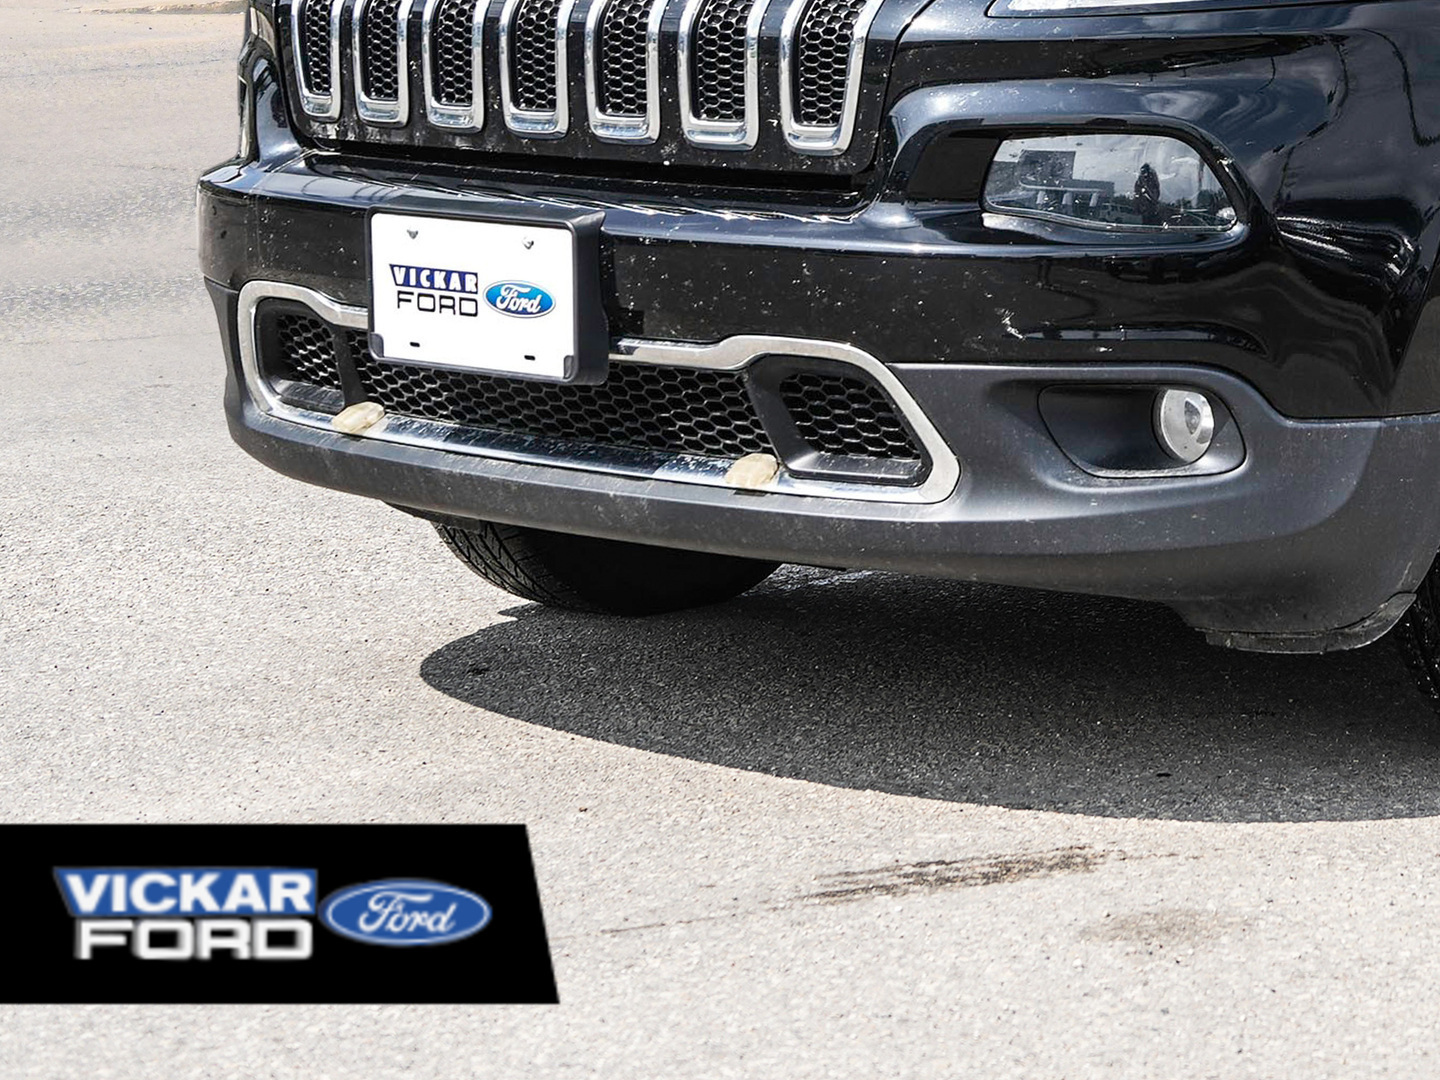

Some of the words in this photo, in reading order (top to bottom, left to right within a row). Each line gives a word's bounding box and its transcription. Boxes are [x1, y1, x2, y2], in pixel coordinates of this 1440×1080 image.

[392, 266, 478, 293] VICKAR
[397, 290, 478, 317] FORD
[496, 284, 543, 313] Ford
